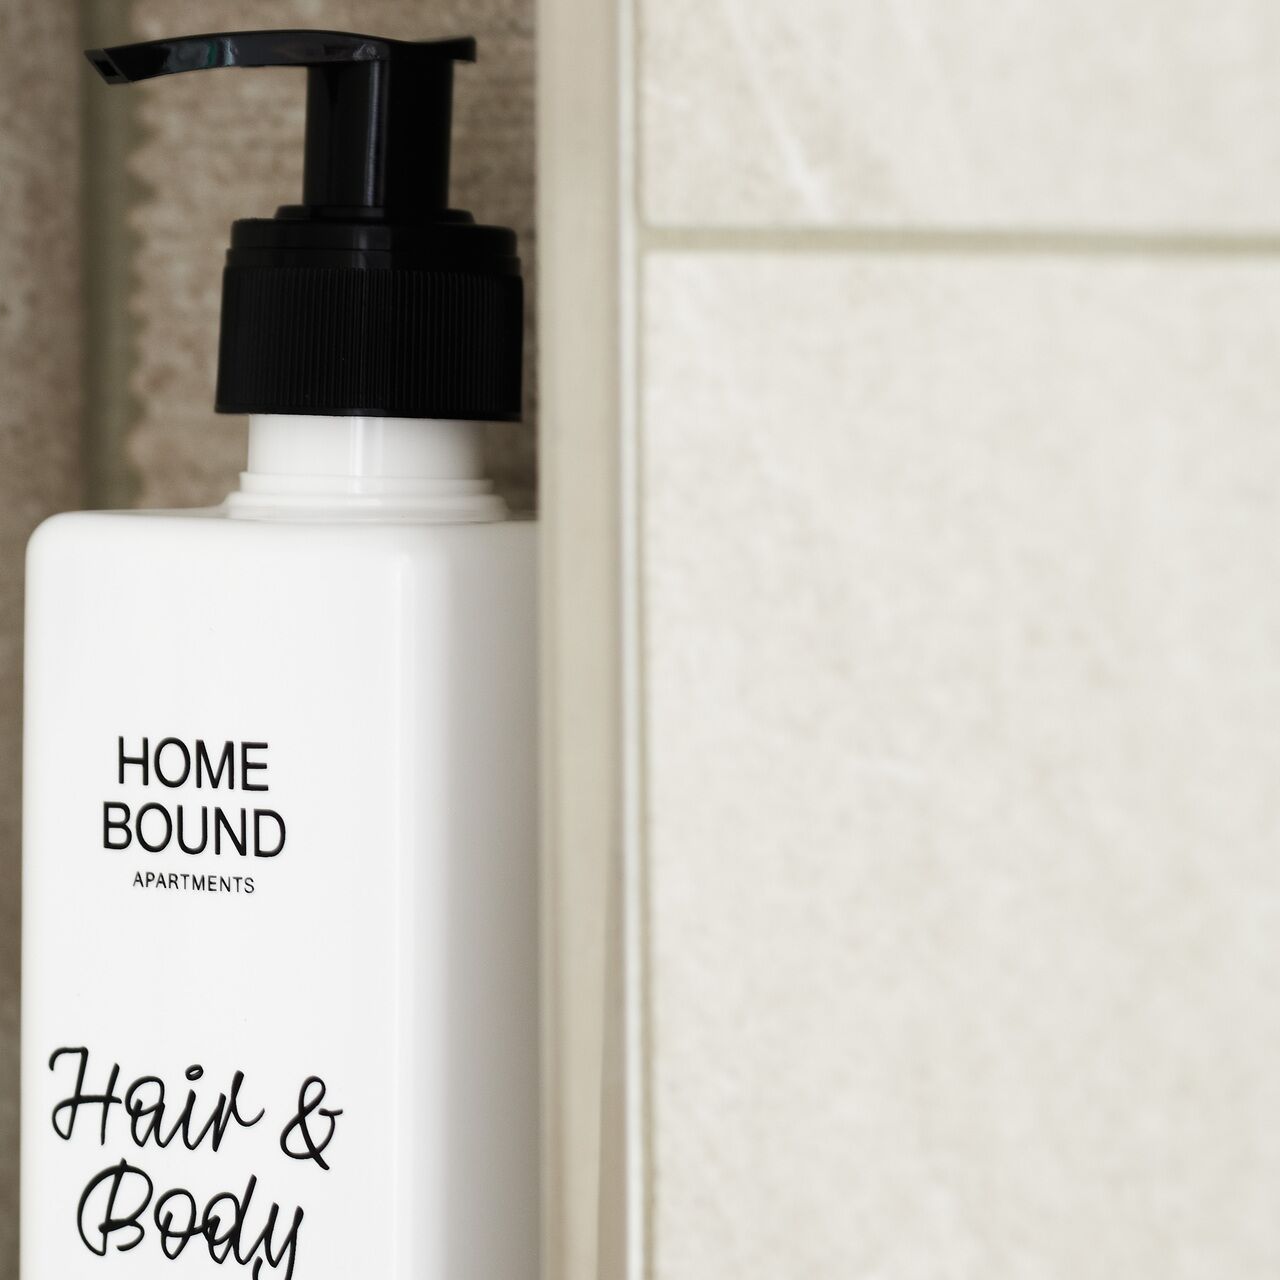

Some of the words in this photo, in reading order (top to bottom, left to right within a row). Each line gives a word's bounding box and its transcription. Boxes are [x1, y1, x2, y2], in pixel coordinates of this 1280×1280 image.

[118, 735, 269, 792] HOME
[103, 801, 287, 858] BOUND
[132, 871, 255, 894] APARTMENTS
[48, 1046, 266, 1153] Hair
[279, 1075, 344, 1171] &
